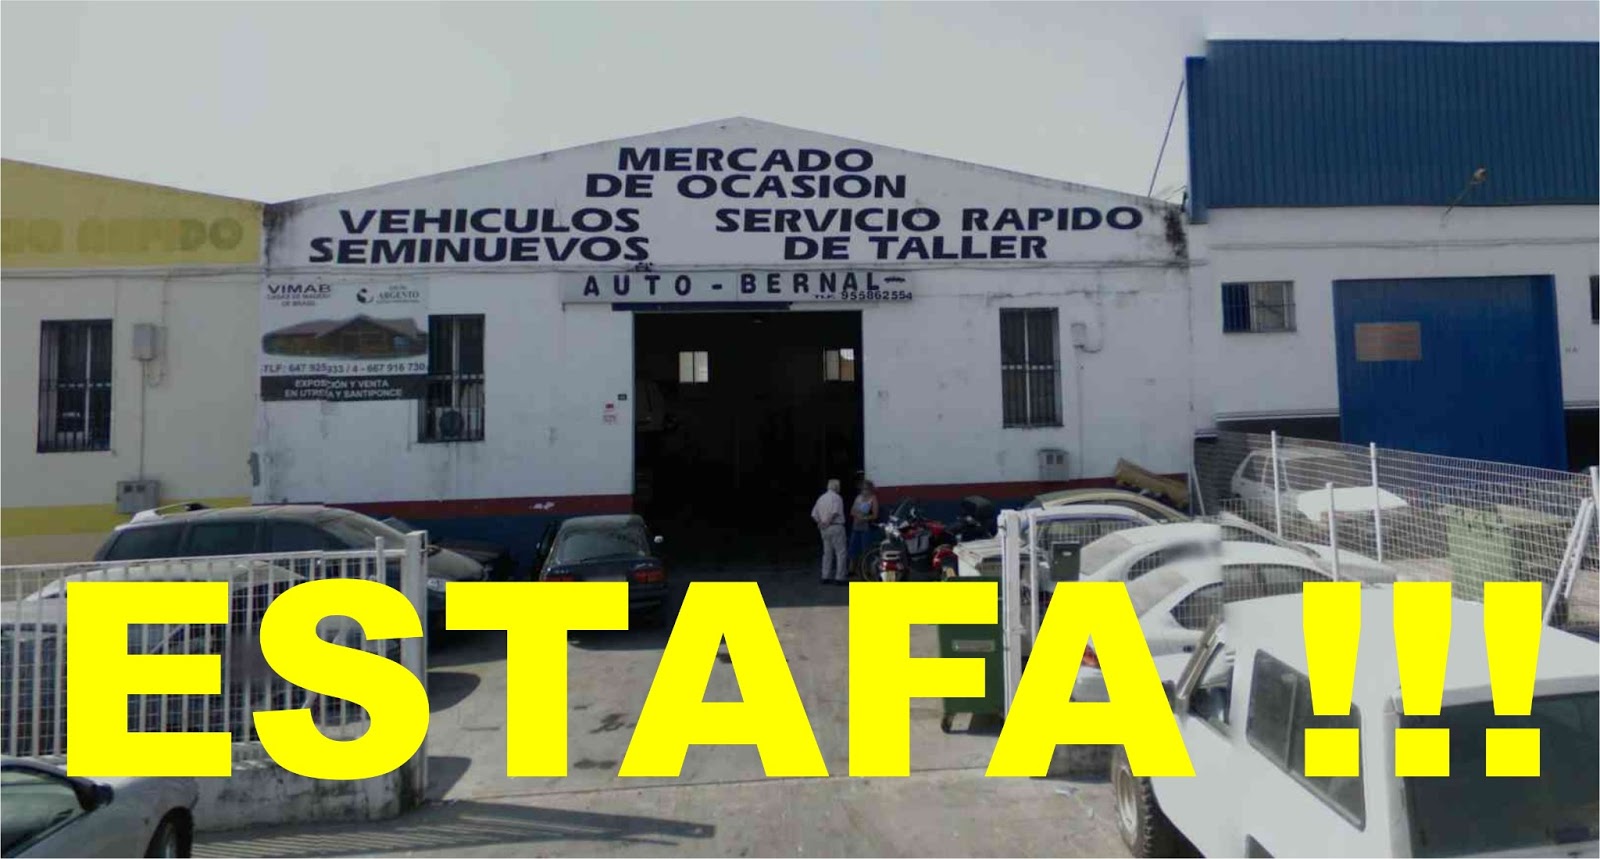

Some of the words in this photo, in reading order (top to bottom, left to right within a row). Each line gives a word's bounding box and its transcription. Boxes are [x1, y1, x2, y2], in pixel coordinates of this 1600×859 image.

[618, 147, 874, 172] MERCADO
[585, 173, 653, 198] DE
[677, 174, 907, 199] OCASION
[339, 207, 640, 234] VEHICULOS
[715, 206, 940, 233] SERVICIO
[962, 206, 1143, 231] RAPIDO
[309, 236, 650, 264] SEMINUEVOS
[784, 236, 850, 260] DE
[868, 236, 1048, 260] TALLER
[267, 284, 331, 294] VIMAB
[583, 274, 692, 297] AUTO
[741, 271, 880, 294] BERNAL
